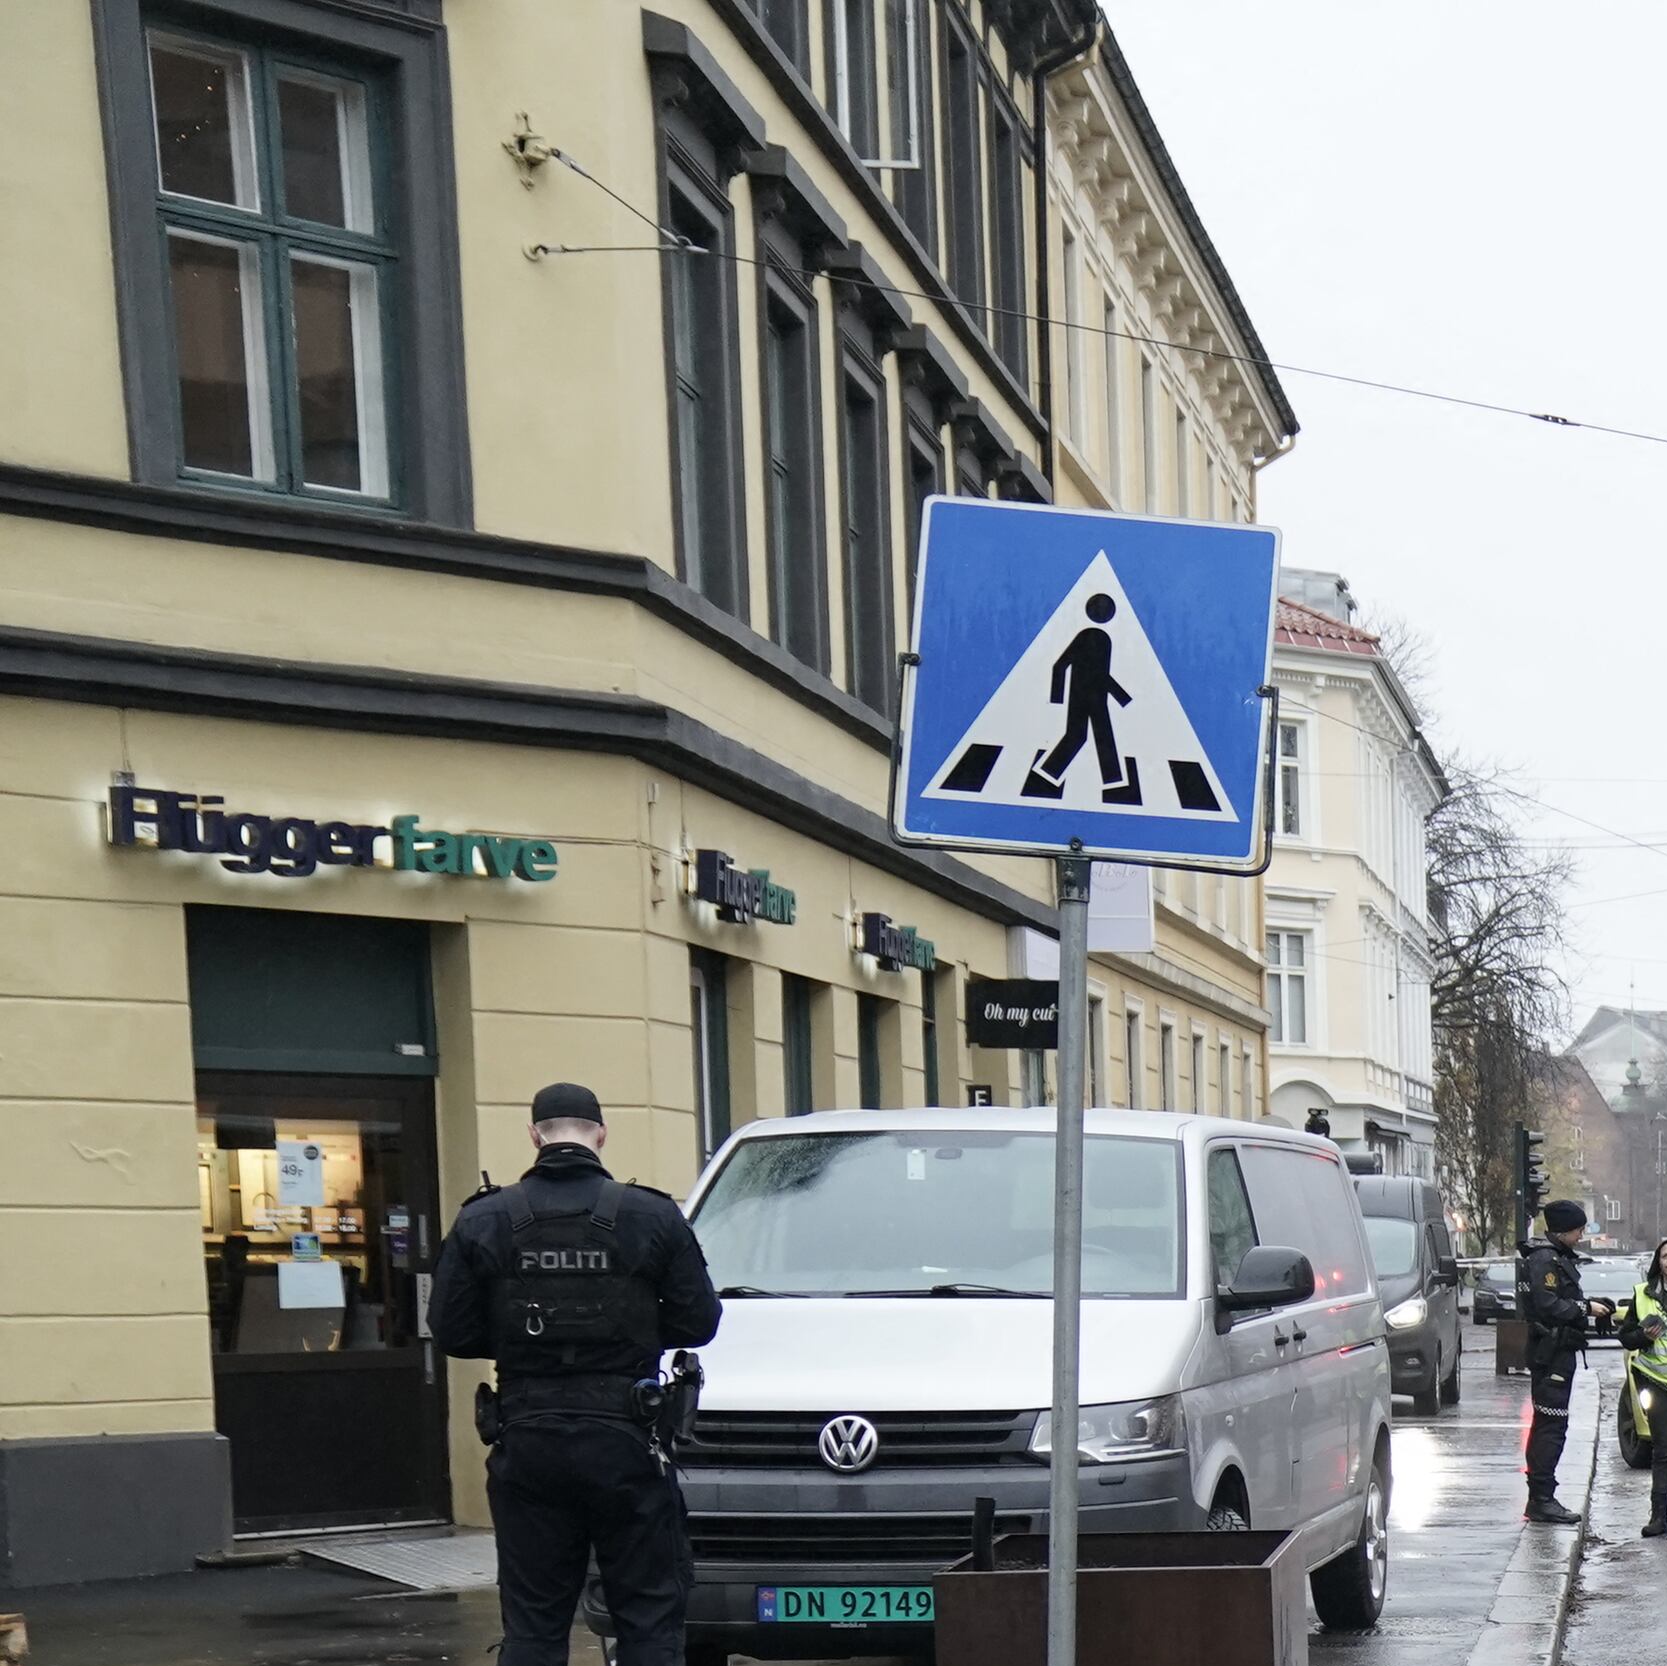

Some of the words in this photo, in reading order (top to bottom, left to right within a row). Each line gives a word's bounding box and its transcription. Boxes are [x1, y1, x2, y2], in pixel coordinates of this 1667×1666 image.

[984, 1003, 1004, 1020] Oh
[1006, 1008, 1030, 1027] my
[521, 1251, 608, 1269] POLITI
[784, 1591, 825, 1618] DN
[841, 1591, 932, 1618] 92149
